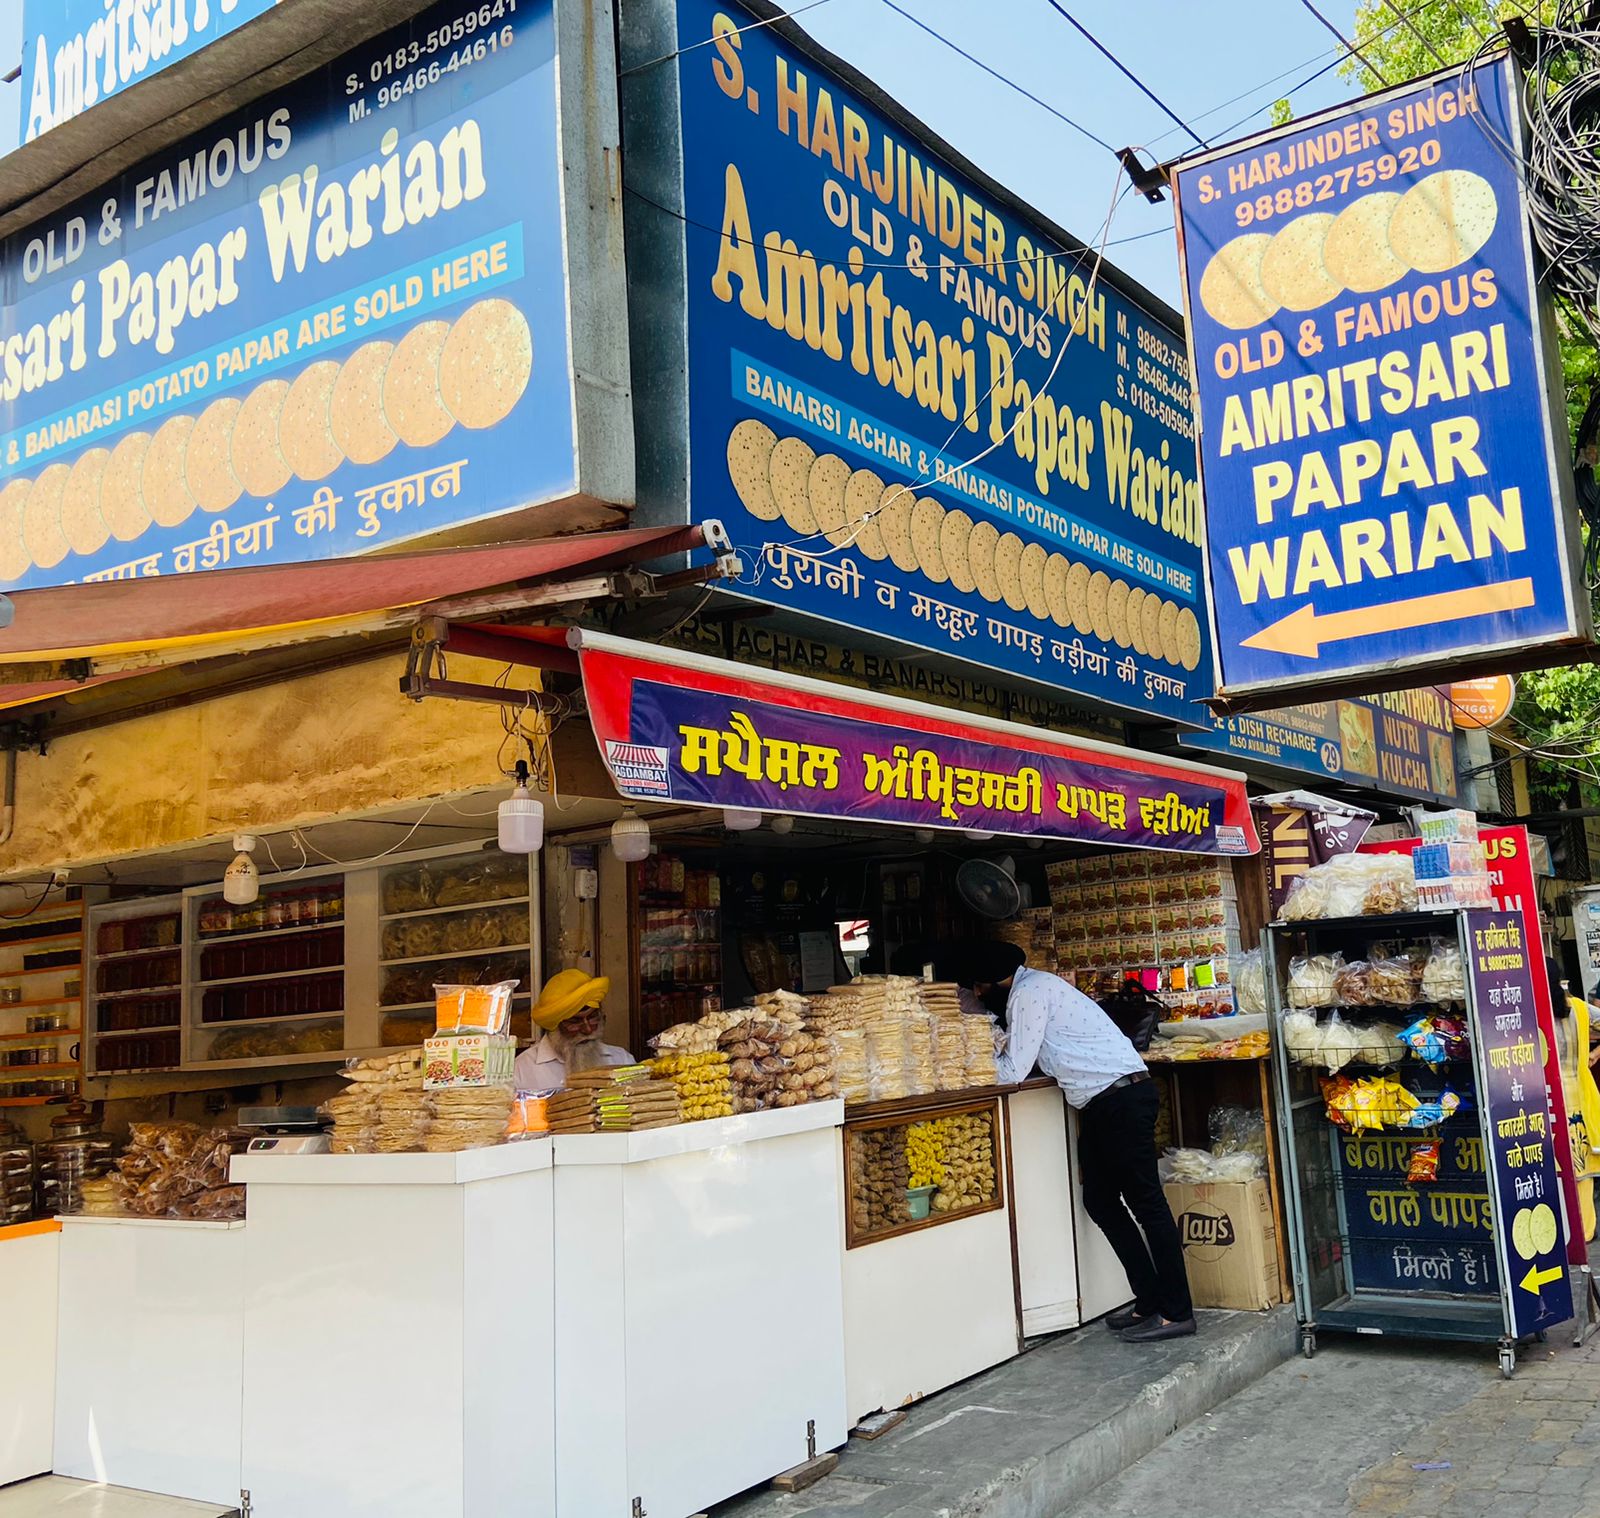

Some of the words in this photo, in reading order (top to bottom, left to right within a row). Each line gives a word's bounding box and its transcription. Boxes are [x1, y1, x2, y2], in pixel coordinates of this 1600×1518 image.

[345, 73, 364, 95] S.
[348, 98, 371, 124] M.
[377, 25, 514, 110] 96466-44616
[711, 12, 760, 115] S.
[776, 55, 1007, 285] HARJINDER
[1015, 235, 1107, 352] SINGH
[1198, 175, 1222, 204] S.
[1228, 117, 1379, 193] HARJINDER
[1387, 88, 1478, 139] SINGH
[1235, 139, 1441, 227] 9888275920
[23, 216, 86, 283] OLD
[98, 198, 123, 246] &
[135, 108, 291, 229] FAMOUS
[98, 227, 247, 358] Papar
[258, 119, 487, 284] Warian
[822, 179, 894, 257] OLD
[906, 234, 928, 282] &
[940, 261, 1051, 358] FAMOUS
[6, 439, 20, 465] &
[25, 396, 121, 458] BANARASI
[128, 361, 209, 417] POTATO
[216, 328, 290, 381] PAPAR
[296, 304, 346, 350] ARE
[353, 275, 423, 327] SOLD
[431, 240, 508, 298] HERE
[711, 163, 979, 433] Amritsari
[987, 330, 1094, 496] Papar
[1100, 400, 1202, 548] Warian
[1116, 310, 1130, 340] M.
[1137, 325, 1192, 384] 98882-759
[1116, 342, 1130, 371] M.
[1214, 329, 1284, 379] OLD
[1297, 318, 1324, 357] &
[1334, 268, 1498, 347] FAMOUS
[1116, 374, 1128, 400] S.
[1219, 323, 1510, 457] AMRITSARI
[292, 486, 343, 538] की
[354, 459, 469, 538] दुकान
[745, 365, 841, 435] BANARSI
[847, 417, 912, 468] ACHAR
[917, 450, 929, 476] &
[935, 458, 1013, 514] BANARASI
[1016, 497, 1068, 538] POTATO
[1071, 522, 1109, 558] PAPAR
[1111, 542, 1134, 569] ARE
[1137, 549, 1163, 581] SOLD
[1166, 568, 1192, 594] HERE
[1252, 416, 1488, 525] PAPAR
[1227, 486, 1526, 605] WARIAN
[764, 543, 865, 599] पुरानी
[875, 580, 900, 610] व
[987, 617, 1044, 663] पापड़
[1050, 638, 1110, 676] वड़ीयां
[1115, 656, 1138, 685] की
[1143, 669, 1187, 700] दुकान
[1229, 735, 1247, 750] ALSO
[1248, 740, 1281, 757] AVAILABLE
[1238, 717, 1264, 739] DISH
[1266, 724, 1317, 752] RECHARGE
[1324, 744, 1338, 770] 29
[1383, 715, 1421, 755] NUTRI
[1444, 699, 1454, 733] &
[679, 711, 841, 791] ਸਪੈਸ਼ਲ
[863, 745, 1043, 821] ਅੰਮ੍ਰਿਤਸਰੀ
[1056, 783, 1127, 831] ਪਾਪੜ
[1138, 792, 1210, 836] ਵੜੀਆਂ
[1381, 750, 1430, 792] KULCHA
[1182, 1213, 1230, 1245] Lay's
[1366, 1185, 1420, 1227] वाले
[1392, 1243, 1454, 1280] मिलते
